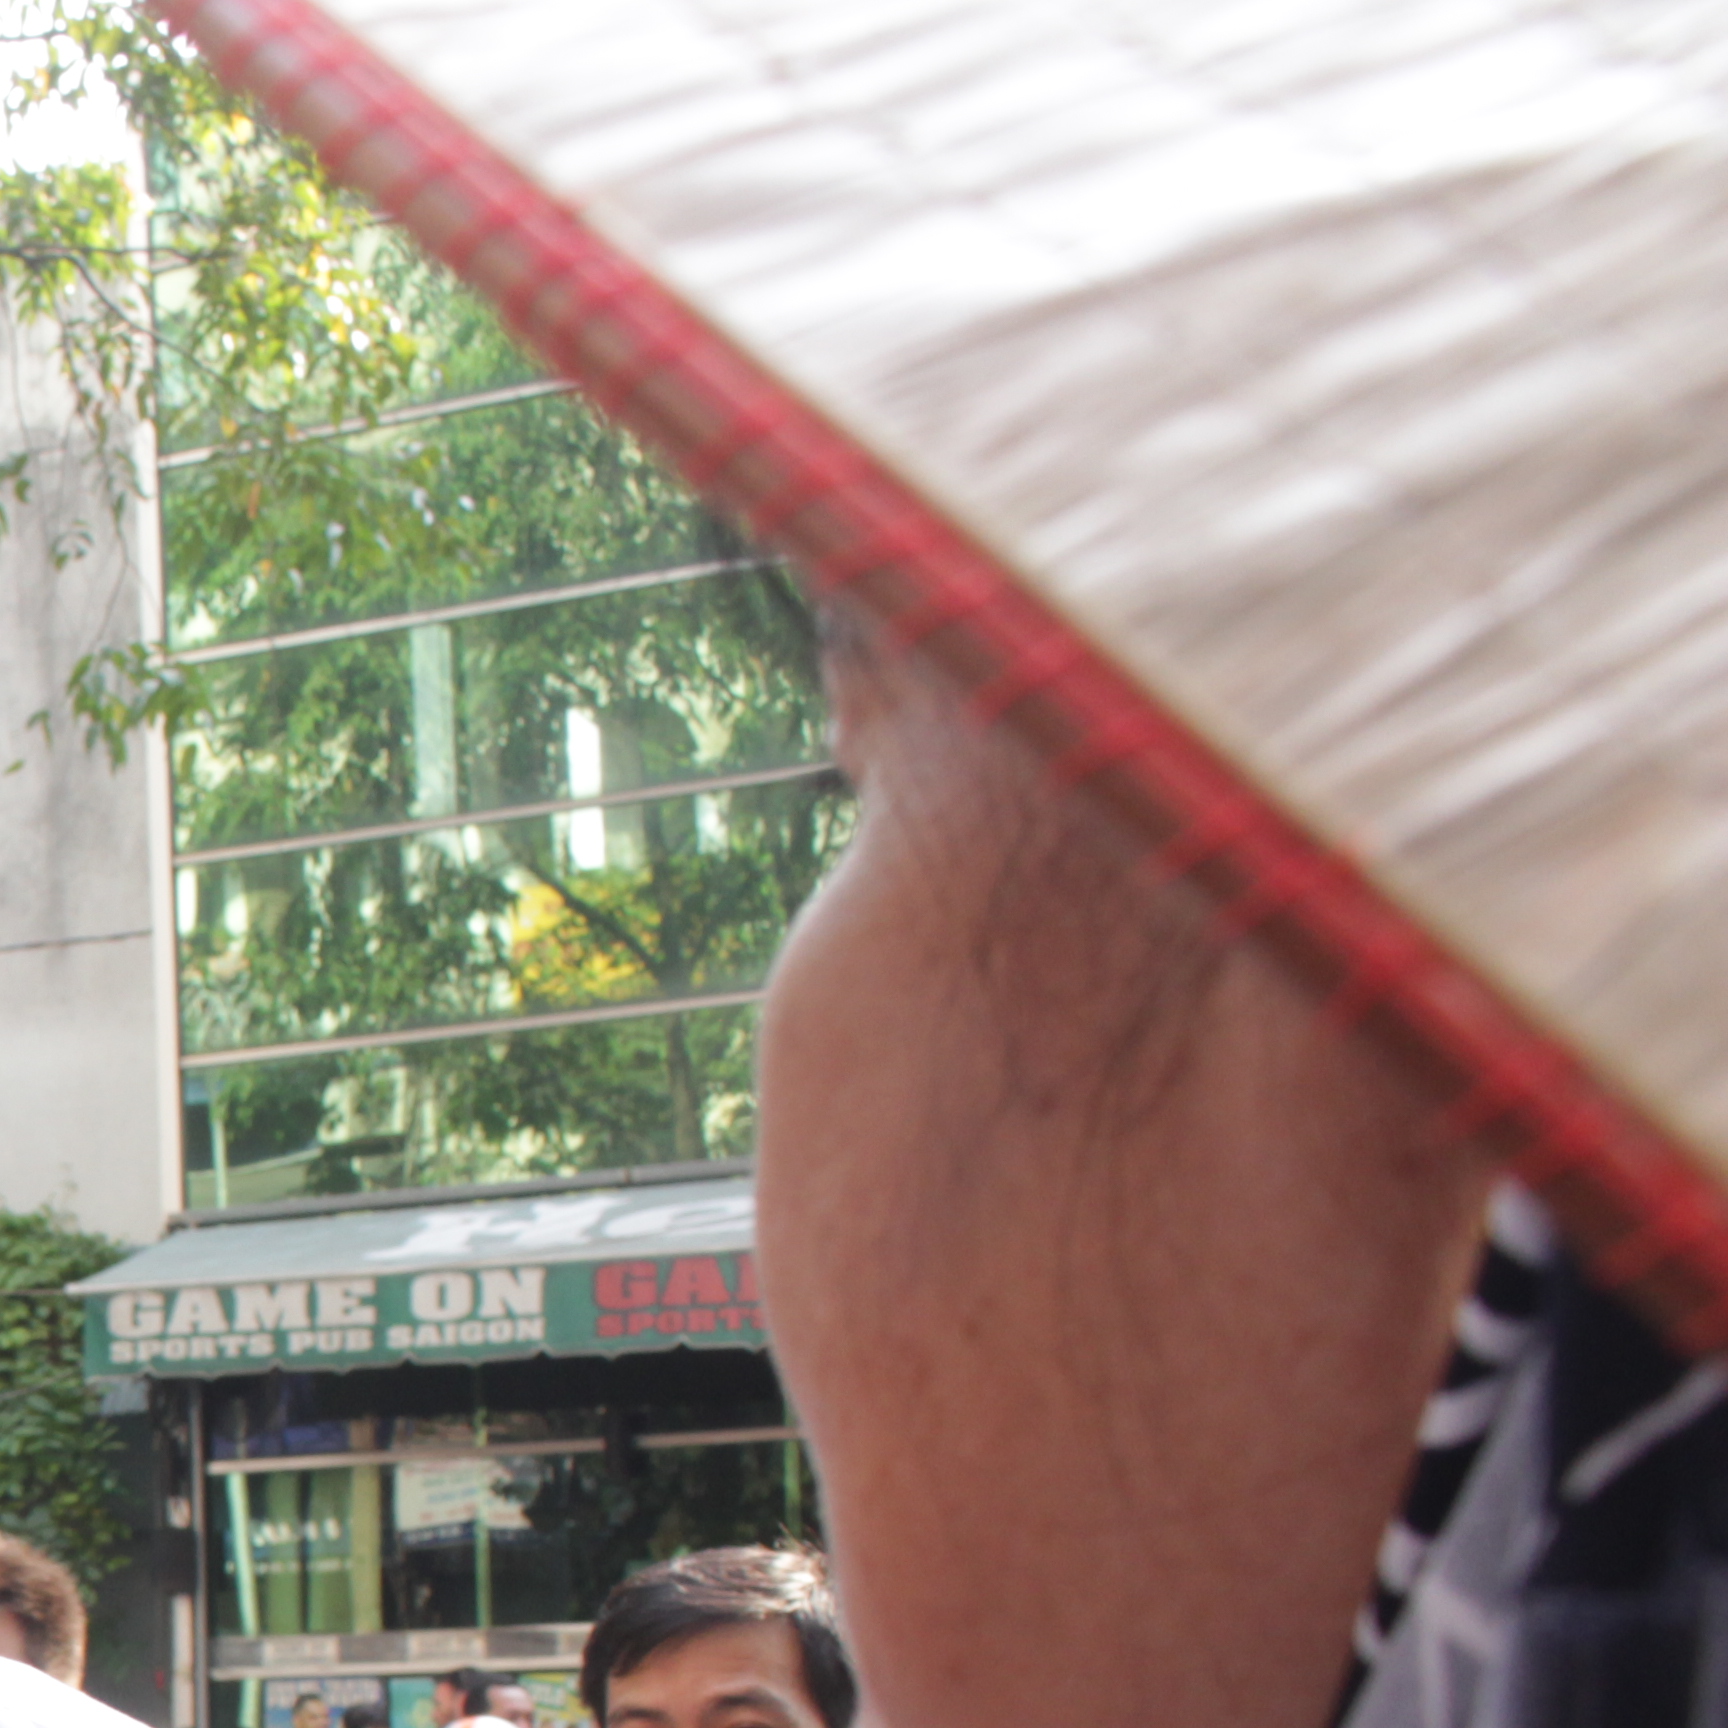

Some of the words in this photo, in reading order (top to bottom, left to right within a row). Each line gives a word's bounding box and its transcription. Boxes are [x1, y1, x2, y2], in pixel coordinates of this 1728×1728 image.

[106, 1276, 378, 1339] GAME
[409, 1265, 547, 1322] ON
[109, 1331, 276, 1365] SPORTS
[287, 1327, 374, 1356] PUB
[386, 1317, 546, 1349] SAIGON
